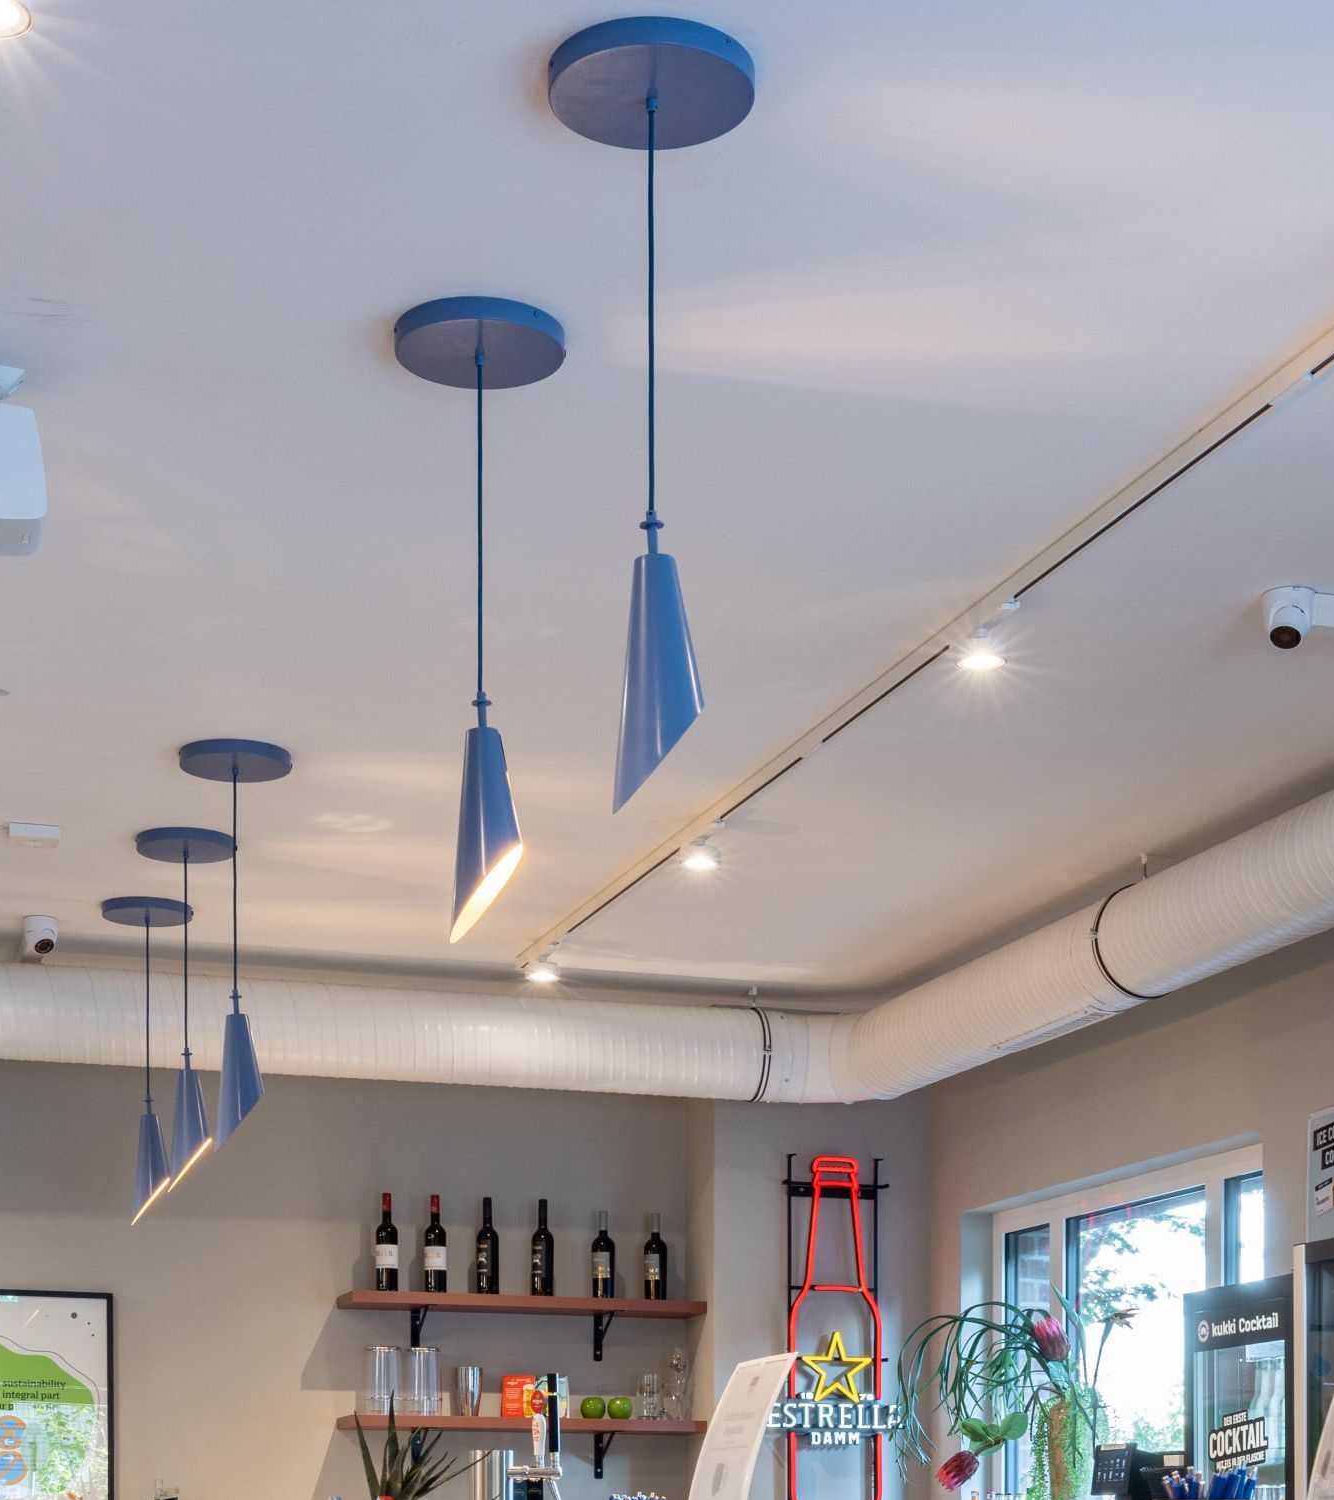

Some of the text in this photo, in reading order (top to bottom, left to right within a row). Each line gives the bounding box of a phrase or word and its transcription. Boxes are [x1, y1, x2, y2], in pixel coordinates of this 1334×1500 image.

[1316, 1130, 1327, 1147] ICE
[1211, 1311, 1279, 1337] kukki Cocktail
[2, 1379, 67, 1390] sustainability
[2, 1390, 39, 1401] integral
[41, 1392, 60, 1401] part
[1223, 1412, 1247, 1427] DER ERSTE
[811, 1431, 860, 1445] DAMM
[1209, 1420, 1267, 1459] COCKTAIL
